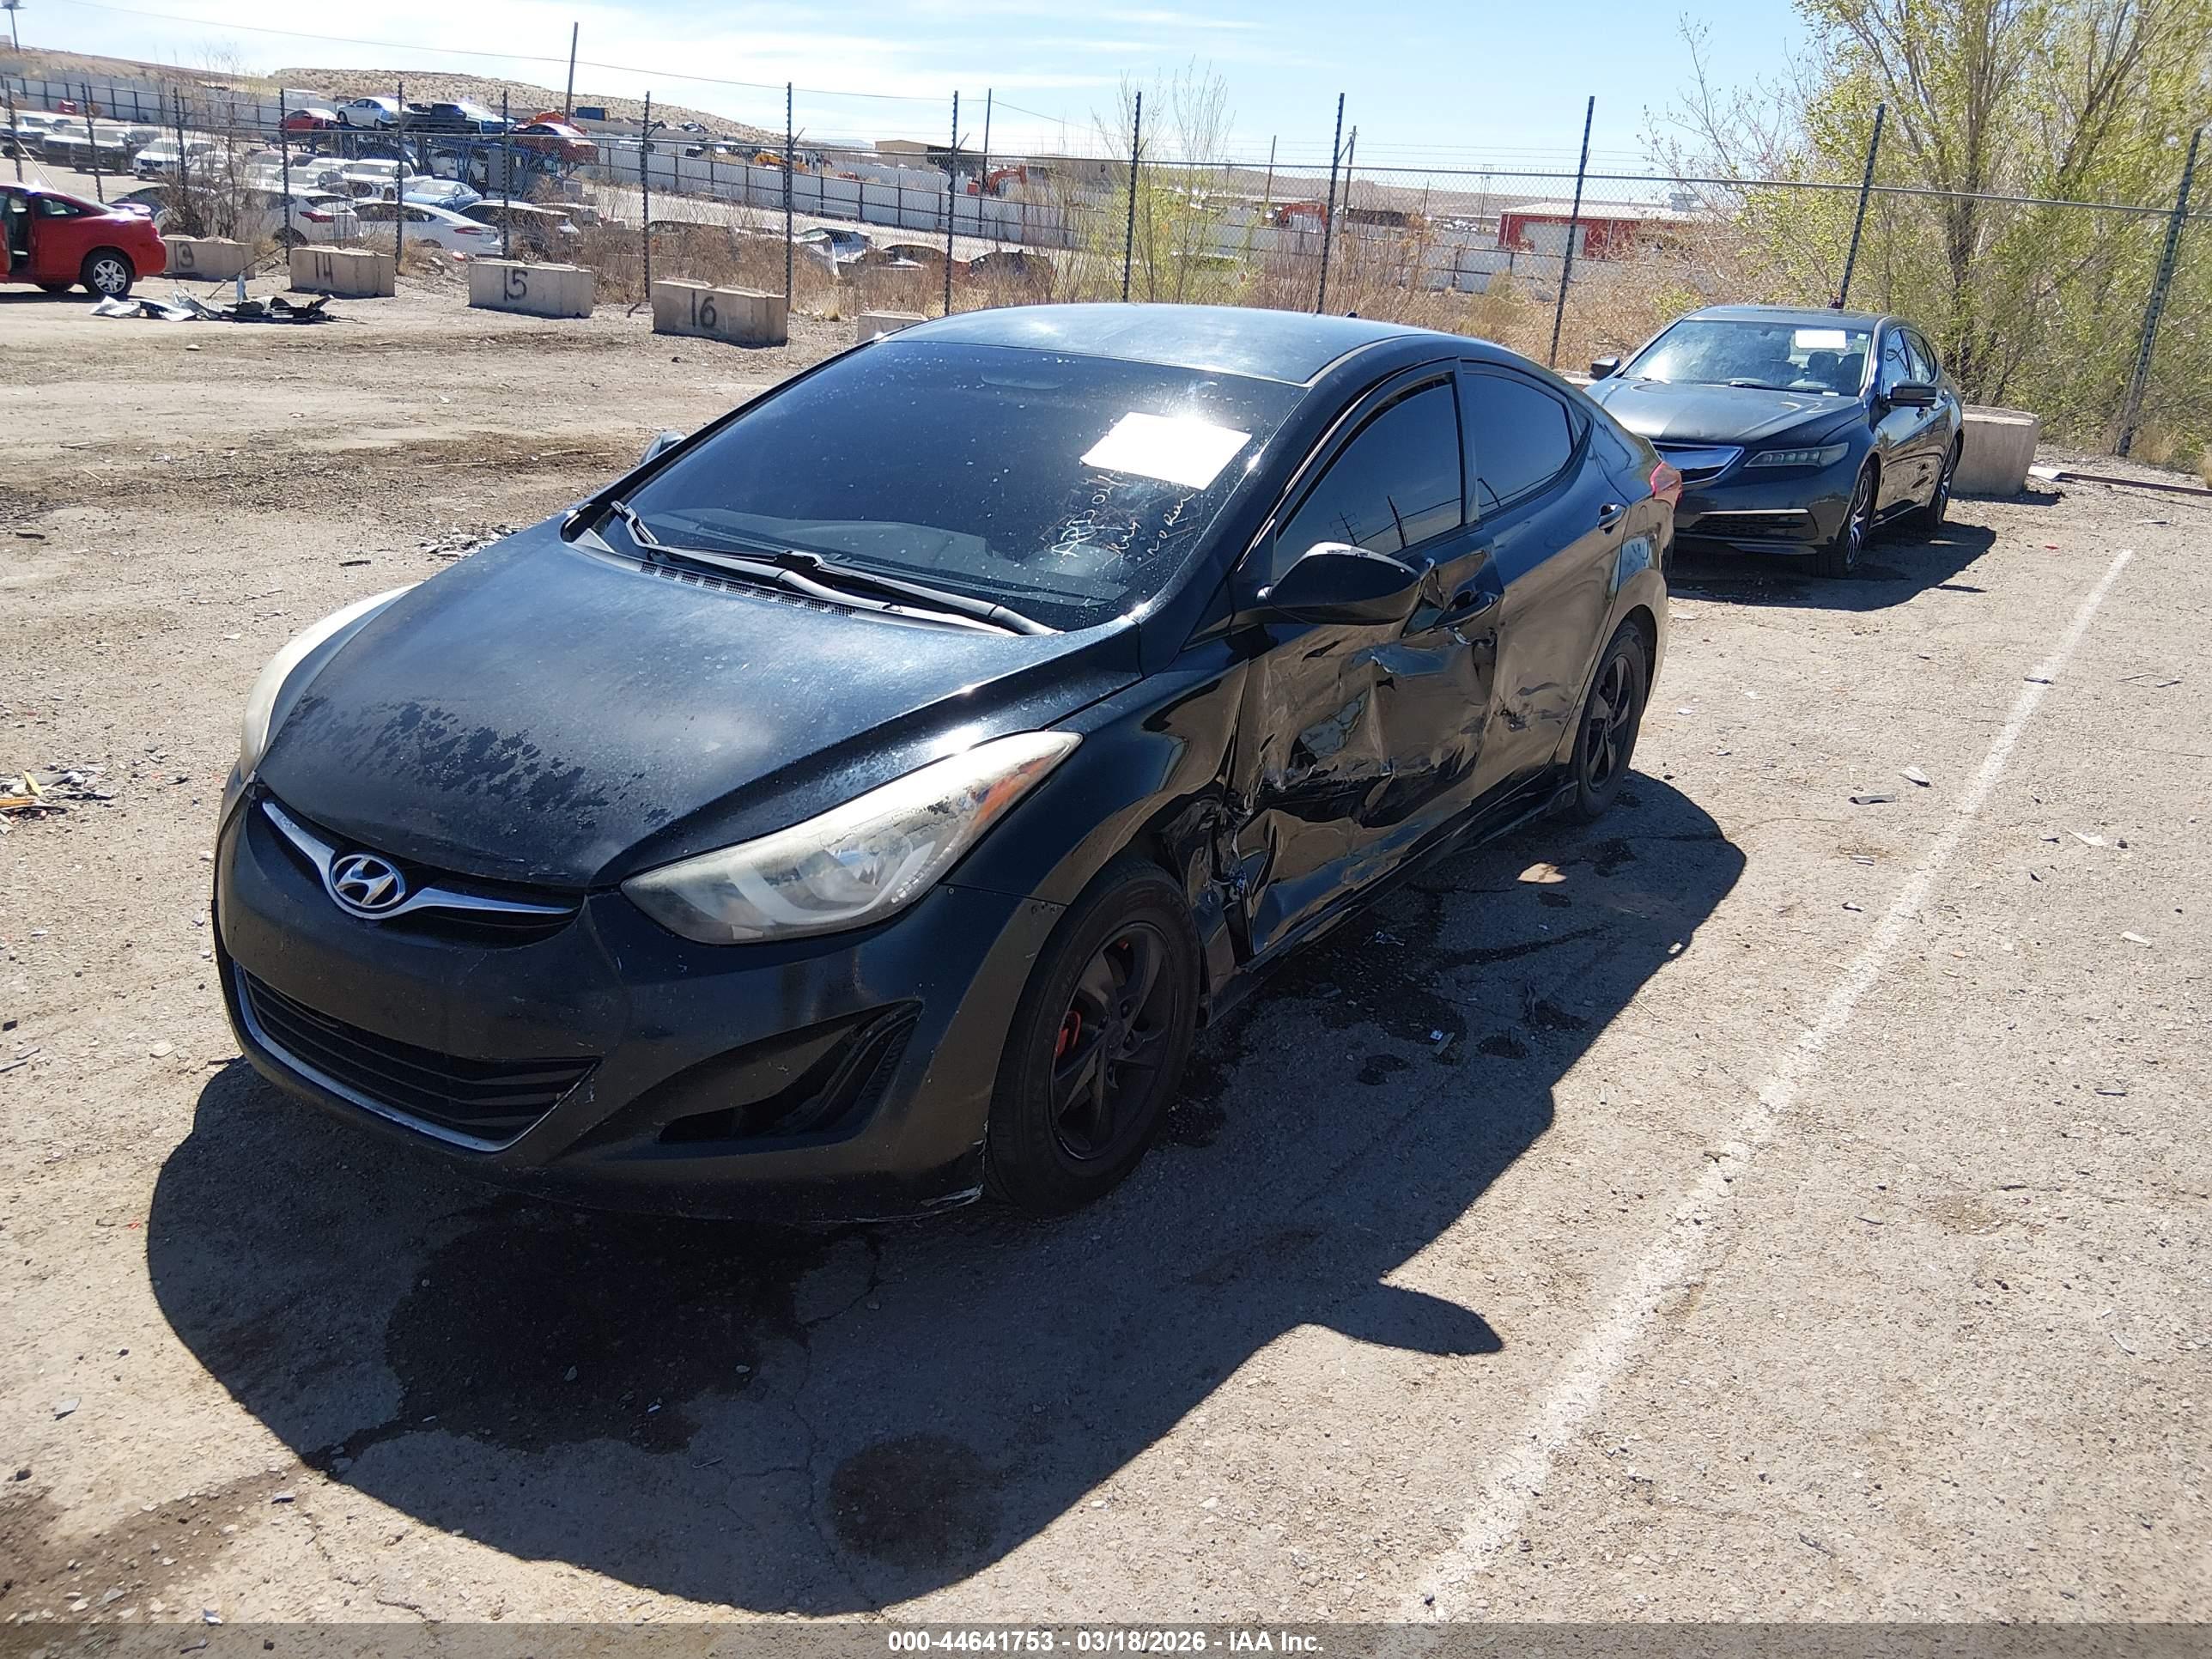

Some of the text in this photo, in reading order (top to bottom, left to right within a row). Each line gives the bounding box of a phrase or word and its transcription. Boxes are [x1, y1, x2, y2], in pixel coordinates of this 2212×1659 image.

[174, 241, 194, 270] 13
[315, 252, 333, 284] 14
[503, 267, 528, 301] 15
[691, 289, 717, 329] 16
